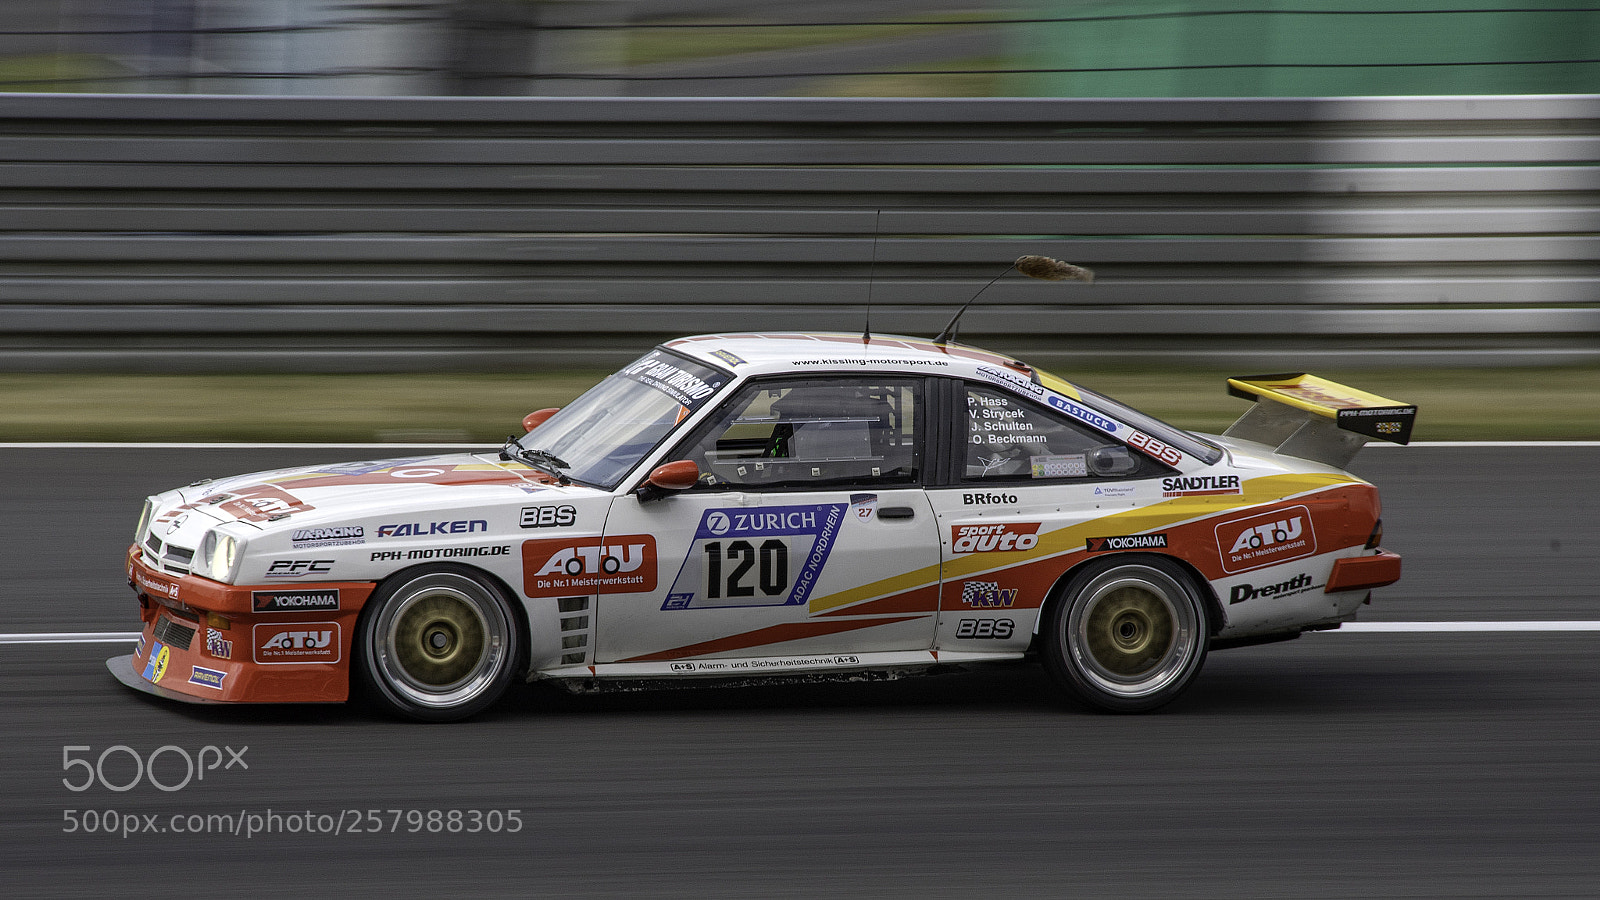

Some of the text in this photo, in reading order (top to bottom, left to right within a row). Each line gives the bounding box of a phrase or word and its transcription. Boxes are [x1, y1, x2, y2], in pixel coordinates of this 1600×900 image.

[792, 358, 948, 367] www.kissling-motorsport.de
[664, 370, 713, 400] TURISMO
[967, 396, 1008, 406] P. Hass
[969, 409, 1025, 420] V. Strycek
[1056, 400, 1109, 429] BASTUCK
[971, 421, 1033, 431] J. Schulten
[973, 434, 1047, 444] O. Beckmann
[1127, 430, 1182, 466] BBS
[1162, 476, 1240, 492] SANDTLER
[963, 493, 1018, 505] BRfoto
[519, 505, 576, 528] BBS
[858, 508, 872, 517] 27
[376, 520, 488, 537] FALKEN
[734, 512, 816, 531] ZURICH
[958, 524, 1005, 536] sport
[953, 532, 1039, 552] auto
[1106, 535, 1166, 549] YOKOHAMA
[370, 546, 511, 561] PPH-MOTORING.DE
[534, 544, 646, 576] ATU
[794, 505, 840, 603] ADAC NORDRHEIN
[268, 560, 335, 571] PFC
[704, 539, 788, 598] 120
[537, 576, 643, 588] Die Nr.1 Meisterwerkstatt
[1230, 572, 1312, 605] Drenth
[274, 594, 336, 606] YOKOHAMA
[971, 588, 1018, 607] KW
[956, 619, 1015, 639] BBS
[260, 631, 333, 649] ATU
[751, 658, 833, 668] Sicherheitstechnik
[834, 656, 858, 664] A+S
